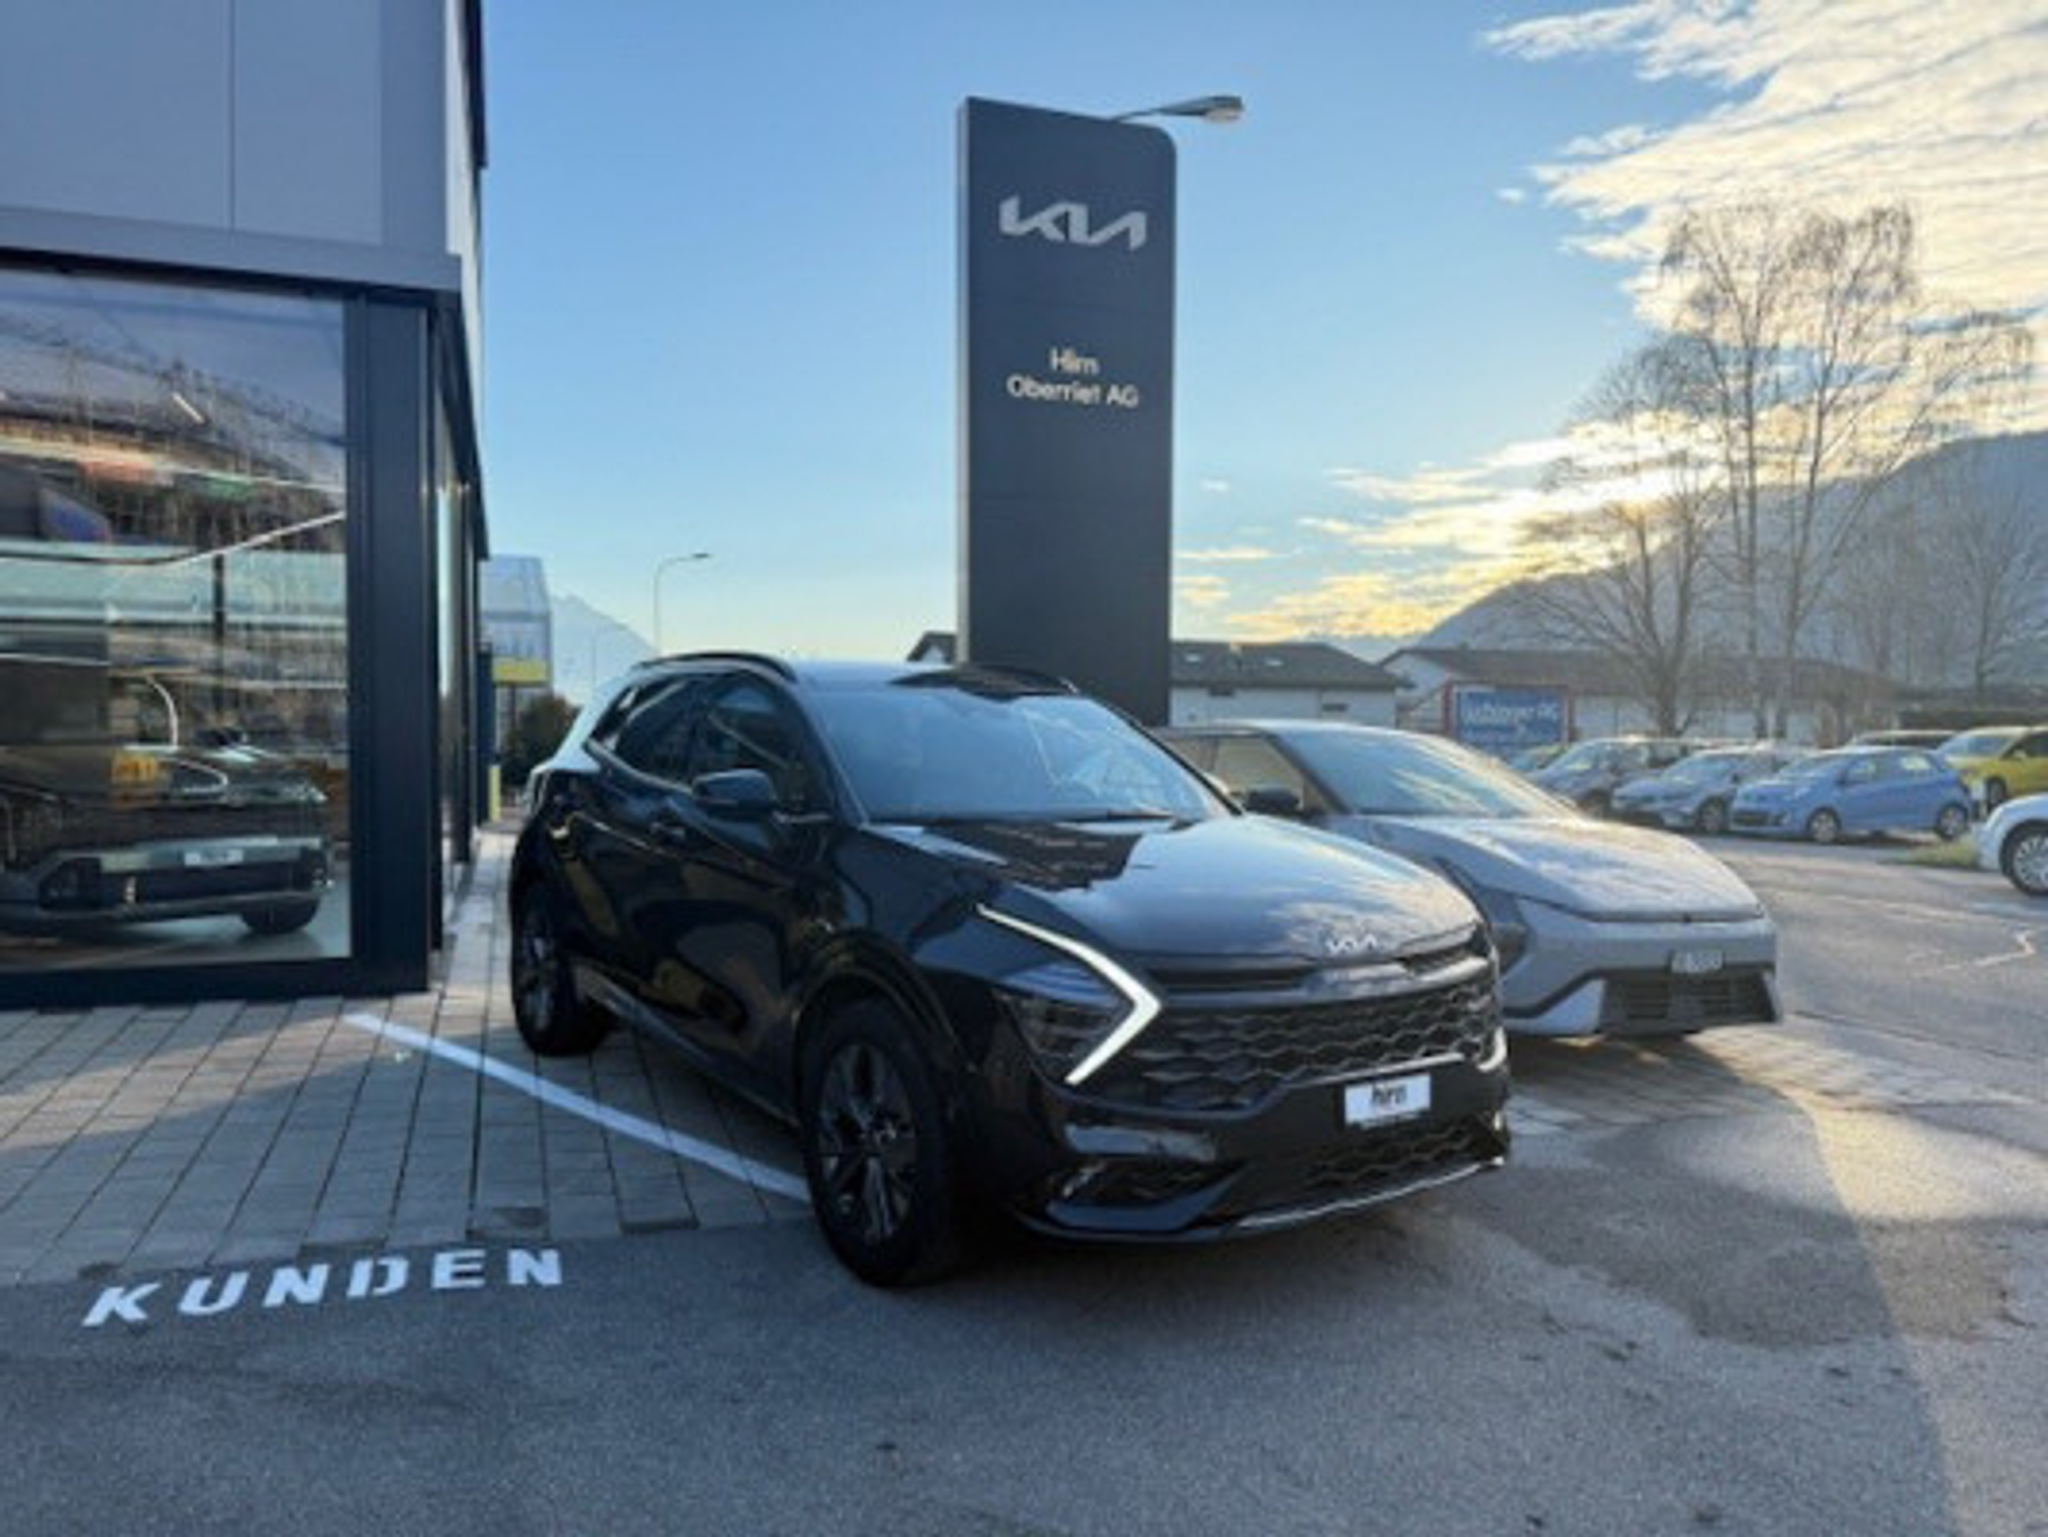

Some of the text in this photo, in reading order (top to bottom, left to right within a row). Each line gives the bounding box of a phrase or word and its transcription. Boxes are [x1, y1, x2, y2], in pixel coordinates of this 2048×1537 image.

[999, 196, 1147, 250] KIA
[1006, 374, 1140, 409] Oberriet AG
[82, 1248, 563, 1327] KUNDEN
